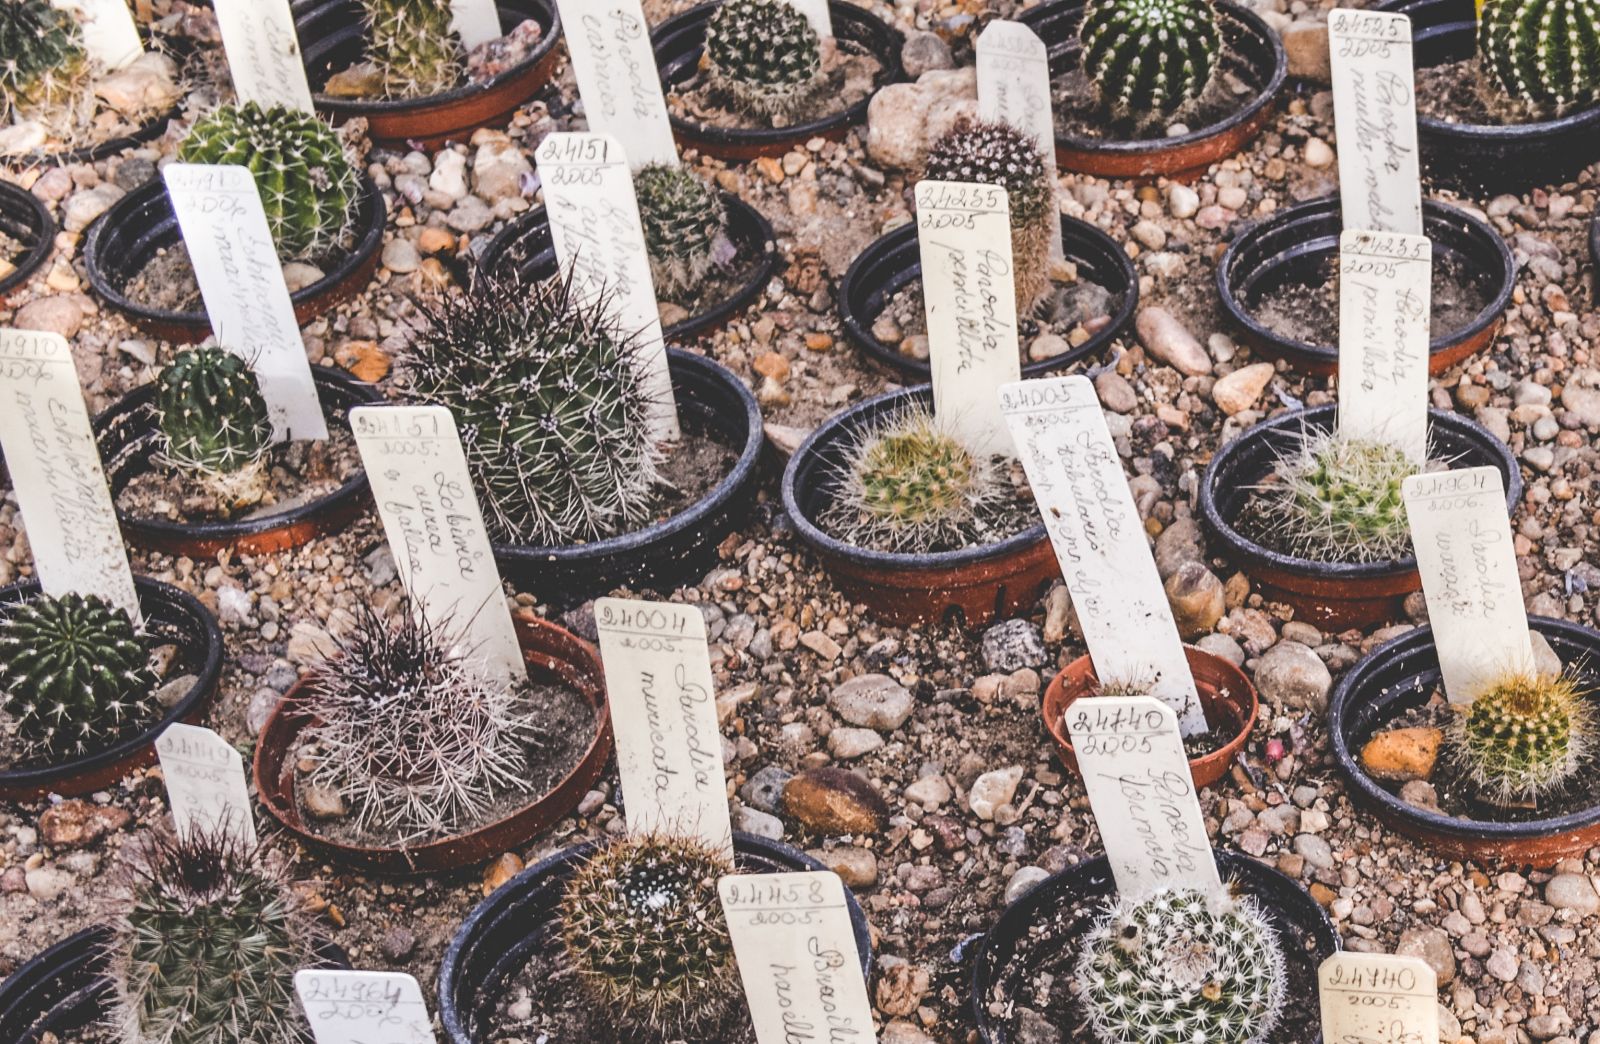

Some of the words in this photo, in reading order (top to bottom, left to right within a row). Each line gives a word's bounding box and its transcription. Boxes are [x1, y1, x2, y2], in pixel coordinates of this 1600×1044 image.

[542, 138, 609, 164] 24151
[929, 241, 985, 375] penicillata
[977, 247, 1010, 353] Parodia
[1392, 287, 1425, 385] Parodia
[1000, 382, 1076, 409] 24005
[412, 484, 442, 557] aurea
[433, 471, 484, 583] Lobivia
[1076, 430, 1124, 542] Parodia
[599, 606, 686, 633] 24004
[1469, 520, 1507, 620] Parodia
[640, 671, 680, 798] muricata
[674, 663, 715, 793] Parodia
[1073, 705, 1164, 733] 24740
[1147, 767, 1206, 875] Parodia
